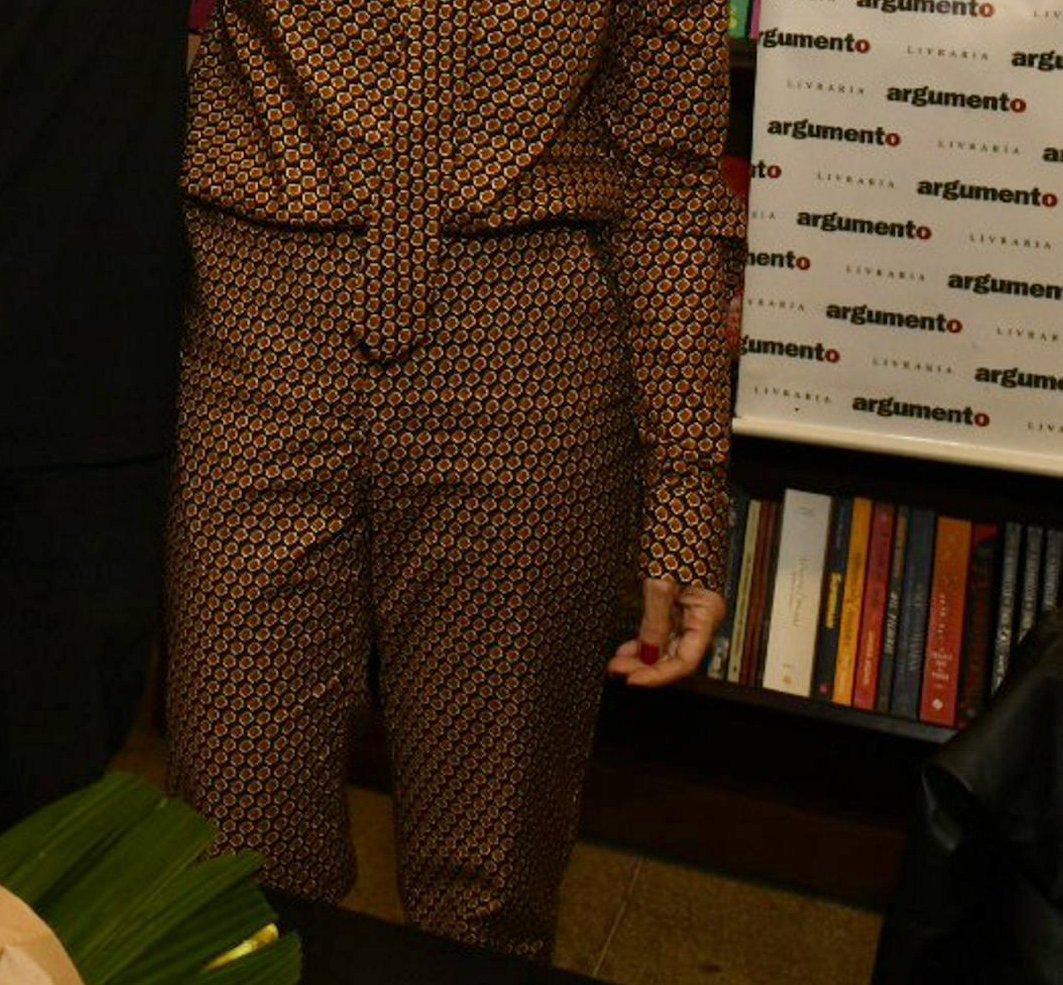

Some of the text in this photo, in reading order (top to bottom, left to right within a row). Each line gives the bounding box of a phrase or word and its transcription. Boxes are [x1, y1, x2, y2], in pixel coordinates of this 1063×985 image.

[887, 85, 1026, 113] argumento
[767, 118, 900, 147] argumento
[916, 179, 1058, 208] argumento
[797, 211, 932, 241] argumento
[826, 303, 963, 334] argumento
[852, 394, 990, 427] argumento
